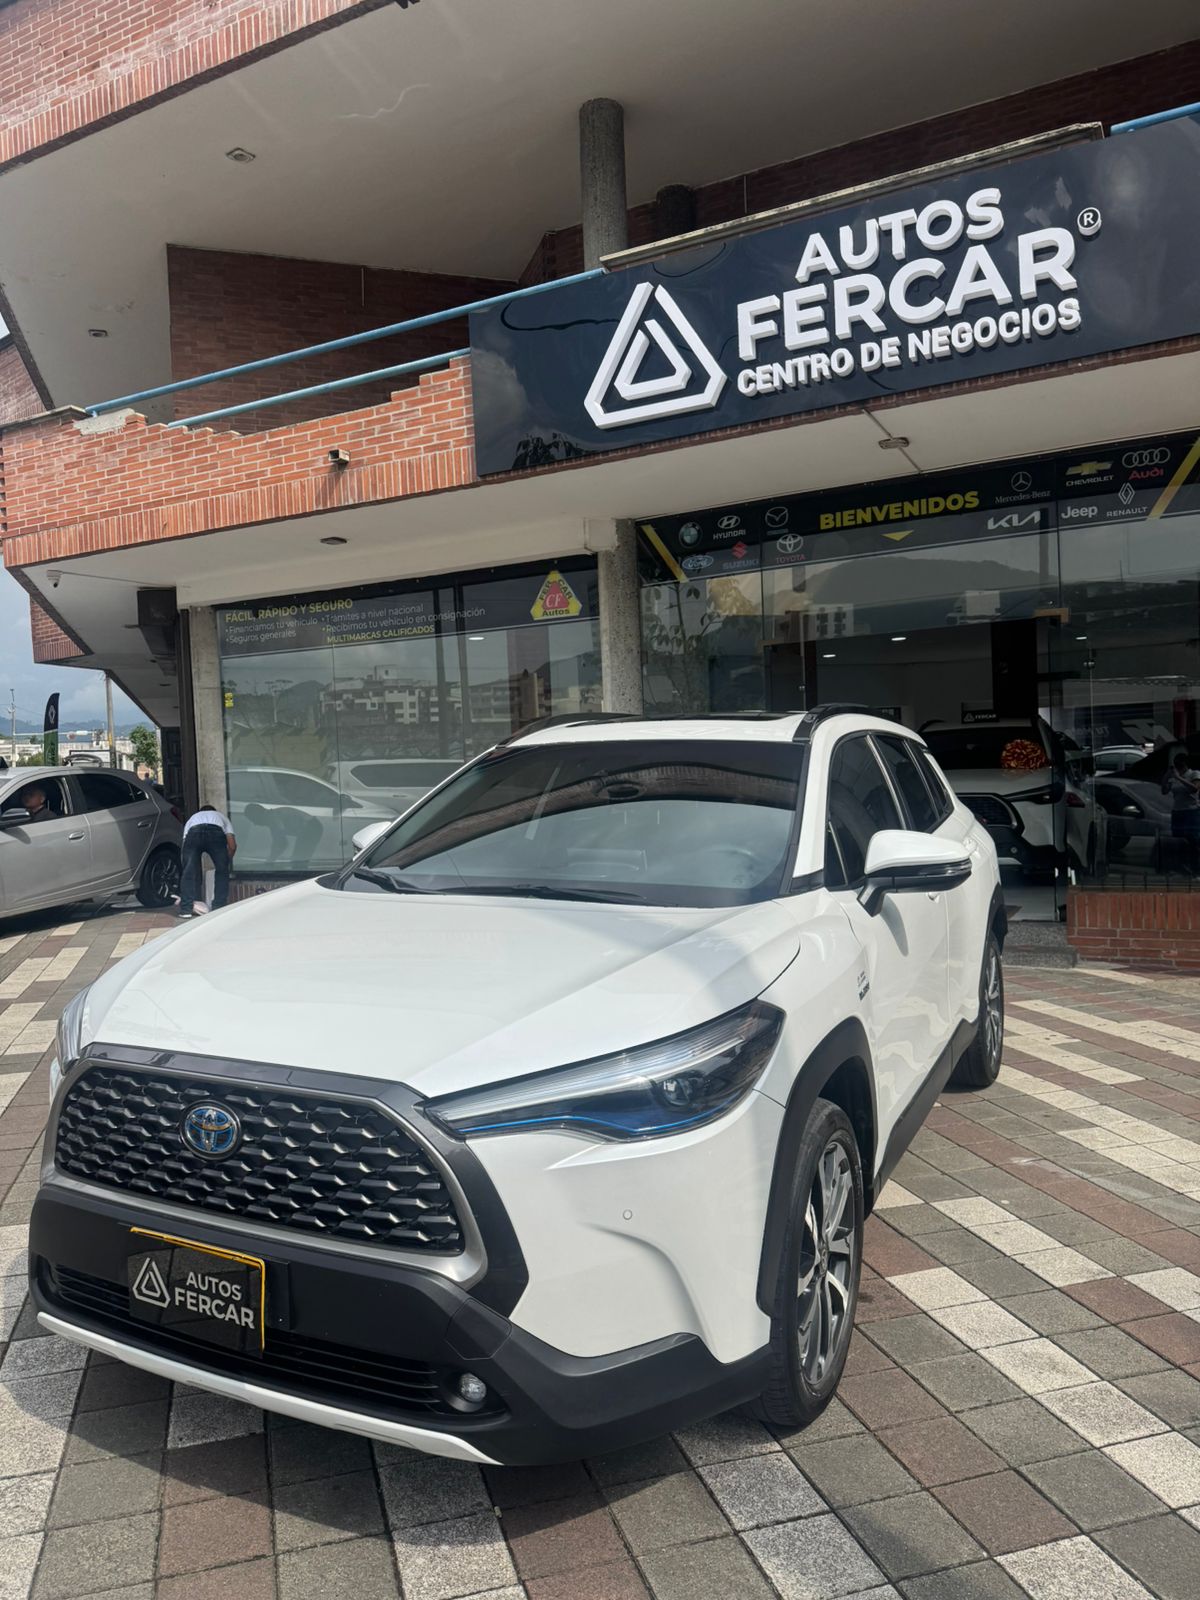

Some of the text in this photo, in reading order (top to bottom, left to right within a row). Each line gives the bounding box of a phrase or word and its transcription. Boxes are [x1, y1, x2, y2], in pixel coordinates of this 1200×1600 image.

[795, 188, 1004, 282] AUTOS
[737, 226, 1077, 361] FERCAR
[737, 298, 1081, 397] CENTRO DE NEGOCIOS
[1066, 474, 1114, 487] CHEVROLET
[995, 490, 1051, 504] Mercedes-Benz
[819, 490, 980, 530] BIENVENIDOS
[1061, 505, 1098, 519] Jeep
[1106, 506, 1148, 518] RENAULT
[713, 529, 746, 540] HYUNDAI
[722, 559, 760, 570] SUZUKI
[776, 553, 806, 564] TOYOTA
[558, 579, 572, 600] CAR
[225, 598, 353, 623] FÁCIL, RÁPIDO Y SEGURO
[367, 607, 387, 619] nivel
[388, 603, 424, 616] nacional
[543, 609, 570, 617] Autos
[276, 621, 285, 630] tu
[326, 621, 368, 634] Recibimos
[369, 620, 378, 629] tu
[415, 614, 427, 623] en
[428, 606, 486, 623] consignación
[229, 629, 297, 646] Seguros generales
[327, 624, 435, 644] MULTIMARCAS CALIFICADOS
[186, 1271, 242, 1301] AUTOS
[174, 1287, 255, 1330] FERCAR
